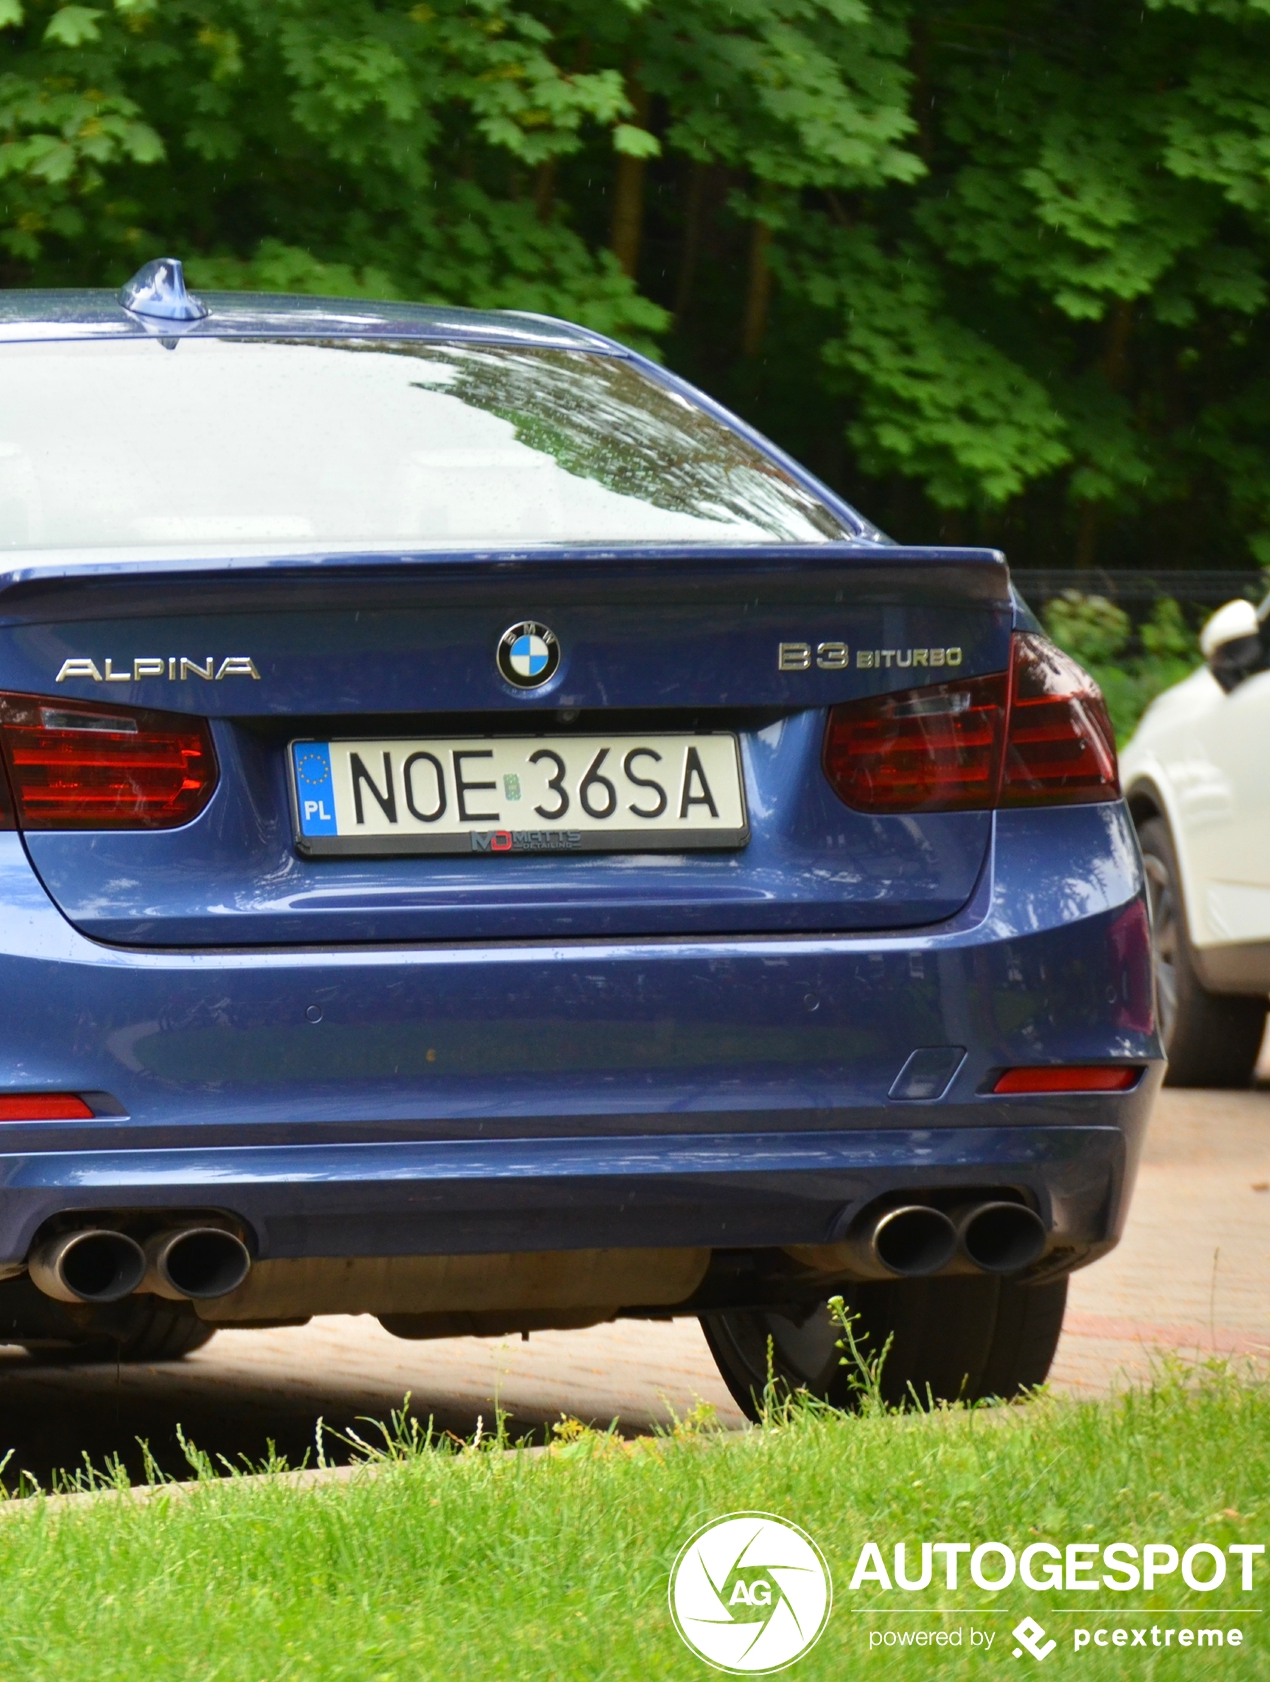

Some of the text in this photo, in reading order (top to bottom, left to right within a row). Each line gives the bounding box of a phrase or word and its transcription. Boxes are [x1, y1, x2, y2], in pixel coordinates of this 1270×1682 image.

[503, 622, 557, 646] BMW
[778, 641, 963, 671] B3 BITURBO
[55, 656, 262, 683] ALPINA
[349, 746, 720, 824] NOE 36SA
[304, 800, 331, 821] PL
[512, 830, 582, 842] MATTS
[522, 842, 574, 850] DETAILING
